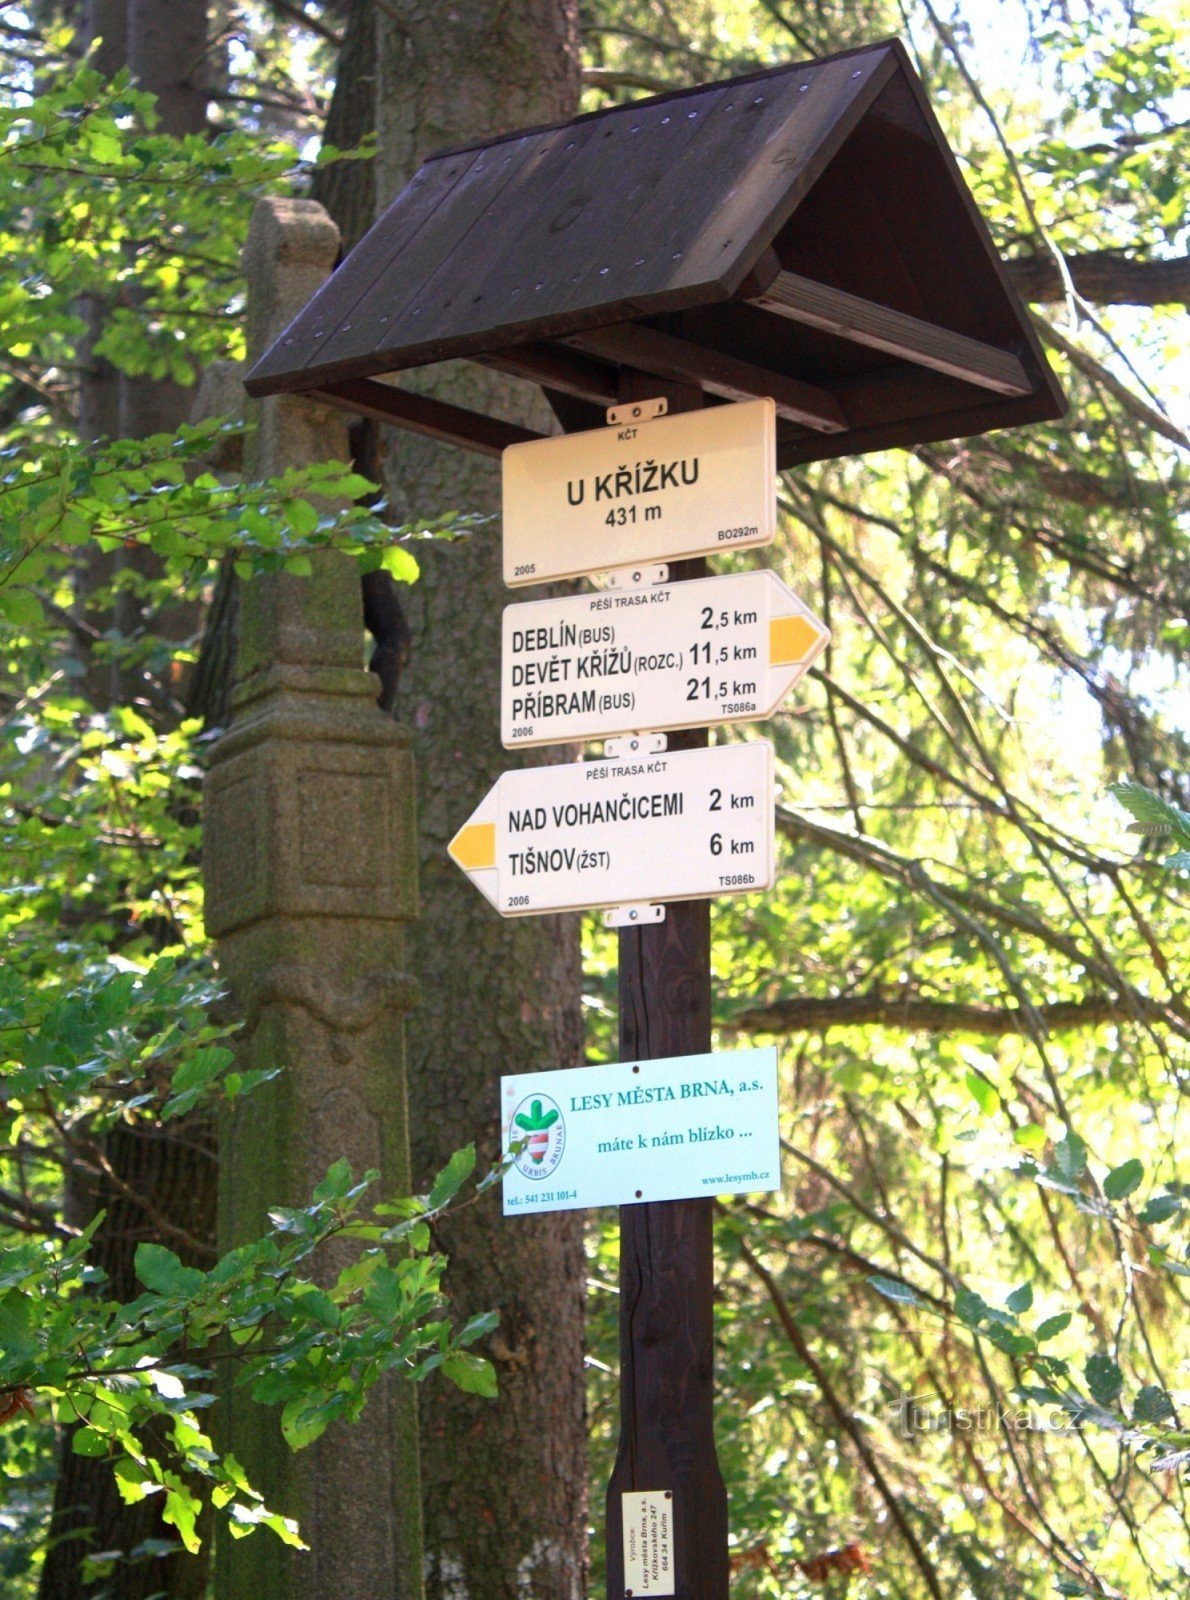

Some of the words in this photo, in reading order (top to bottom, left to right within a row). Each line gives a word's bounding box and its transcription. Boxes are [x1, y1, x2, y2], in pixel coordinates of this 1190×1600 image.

[617, 428, 638, 441] KČT
[567, 479, 584, 506] U
[595, 457, 699, 502] KŘÍŽKU
[605, 505, 637, 528] 431
[645, 503, 662, 521] m
[514, 564, 536, 576] 2005
[615, 594, 648, 609] TRASA
[650, 591, 671, 604] KČT
[701, 606, 729, 631] 2,5
[734, 610, 757, 626] km
[512, 659, 571, 687] DEVĚT
[689, 641, 729, 666] 11,5
[733, 646, 757, 661] km
[686, 676, 729, 701] 21,5
[733, 681, 756, 697] km
[721, 702, 756, 715] TS086a
[512, 726, 534, 738] 2006
[611, 764, 645, 778] TRASA
[647, 761, 667, 773] KČT
[508, 807, 547, 833] NAD
[552, 792, 684, 828] VOHANČICEMI
[708, 788, 722, 811] 2
[730, 793, 754, 809] km
[709, 833, 722, 856] 6
[730, 839, 754, 855] km
[719, 874, 755, 887] TS086b
[508, 895, 530, 907] 2006
[570, 1092, 613, 1113] LESY
[617, 1086, 676, 1107] MĚSTA
[680, 1080, 735, 1099] BRNA,
[739, 1079, 764, 1093] a.s.
[597, 1135, 634, 1153] máte
[637, 1133, 648, 1149] k
[651, 1128, 684, 1147] nám
[688, 1125, 735, 1144] blízko
[522, 1164, 548, 1177] URBIS
[702, 1170, 770, 1186] www.lesymb.cz
[525, 1194, 539, 1204] 541
[541, 1192, 554, 1202] 231
[557, 1190, 577, 1200] 101-4
[661, 1543, 668, 1554] 34
[642, 1568, 650, 1589] Lesy
